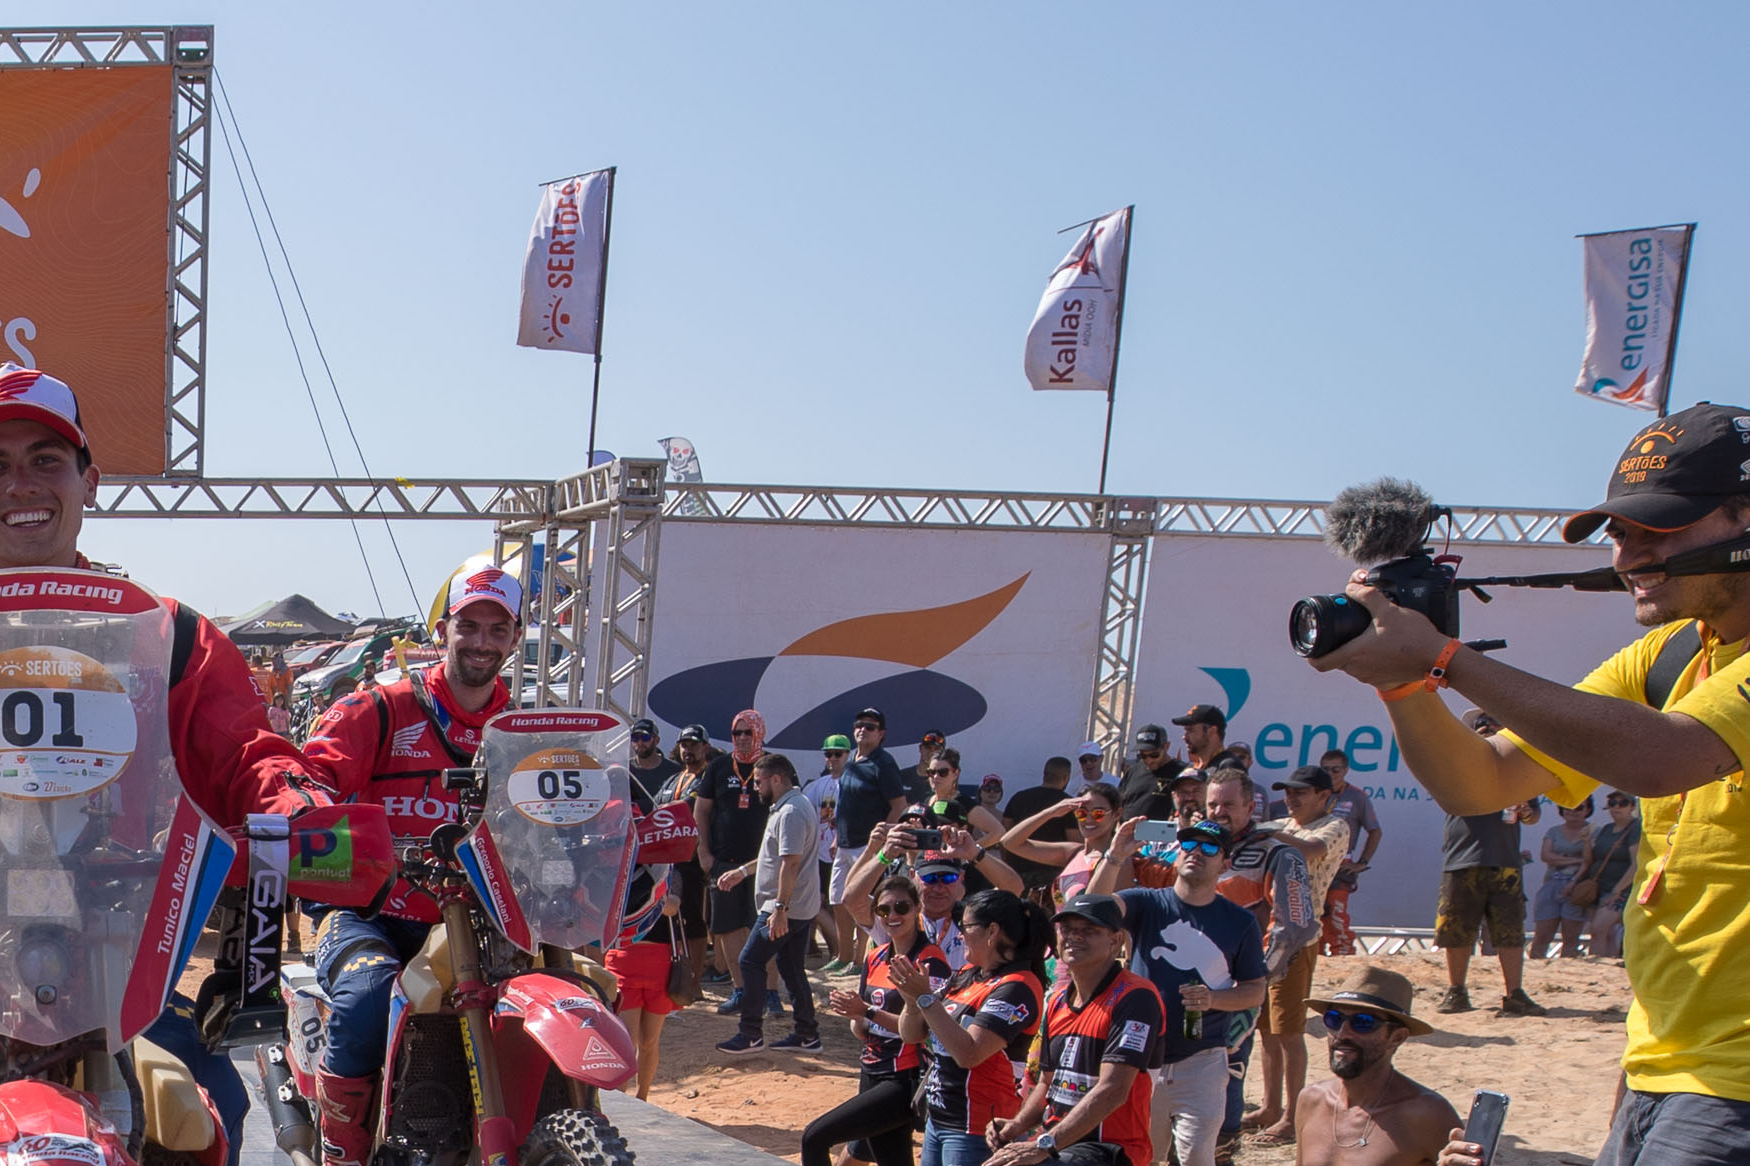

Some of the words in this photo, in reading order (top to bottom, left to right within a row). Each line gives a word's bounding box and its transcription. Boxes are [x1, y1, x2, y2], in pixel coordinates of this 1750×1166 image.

[1049, 298, 1082, 384] Kallas
[1623, 470, 1647, 484] 2019
[39, 581, 123, 605] Racing
[2, 690, 83, 747] 01
[510, 717, 554, 727] Honda
[556, 716, 599, 727] Racing
[537, 770, 583, 799] 05
[1393, 787, 1418, 801] NA
[300, 867, 351, 881] pontual
[157, 898, 180, 954] Tunico
[171, 833, 196, 893] Maciel
[1288, 879, 1305, 924] Avaliar
[248, 869, 282, 993] GAIA
[301, 1017, 327, 1053] 05
[580, 1062, 625, 1071] HONDA
